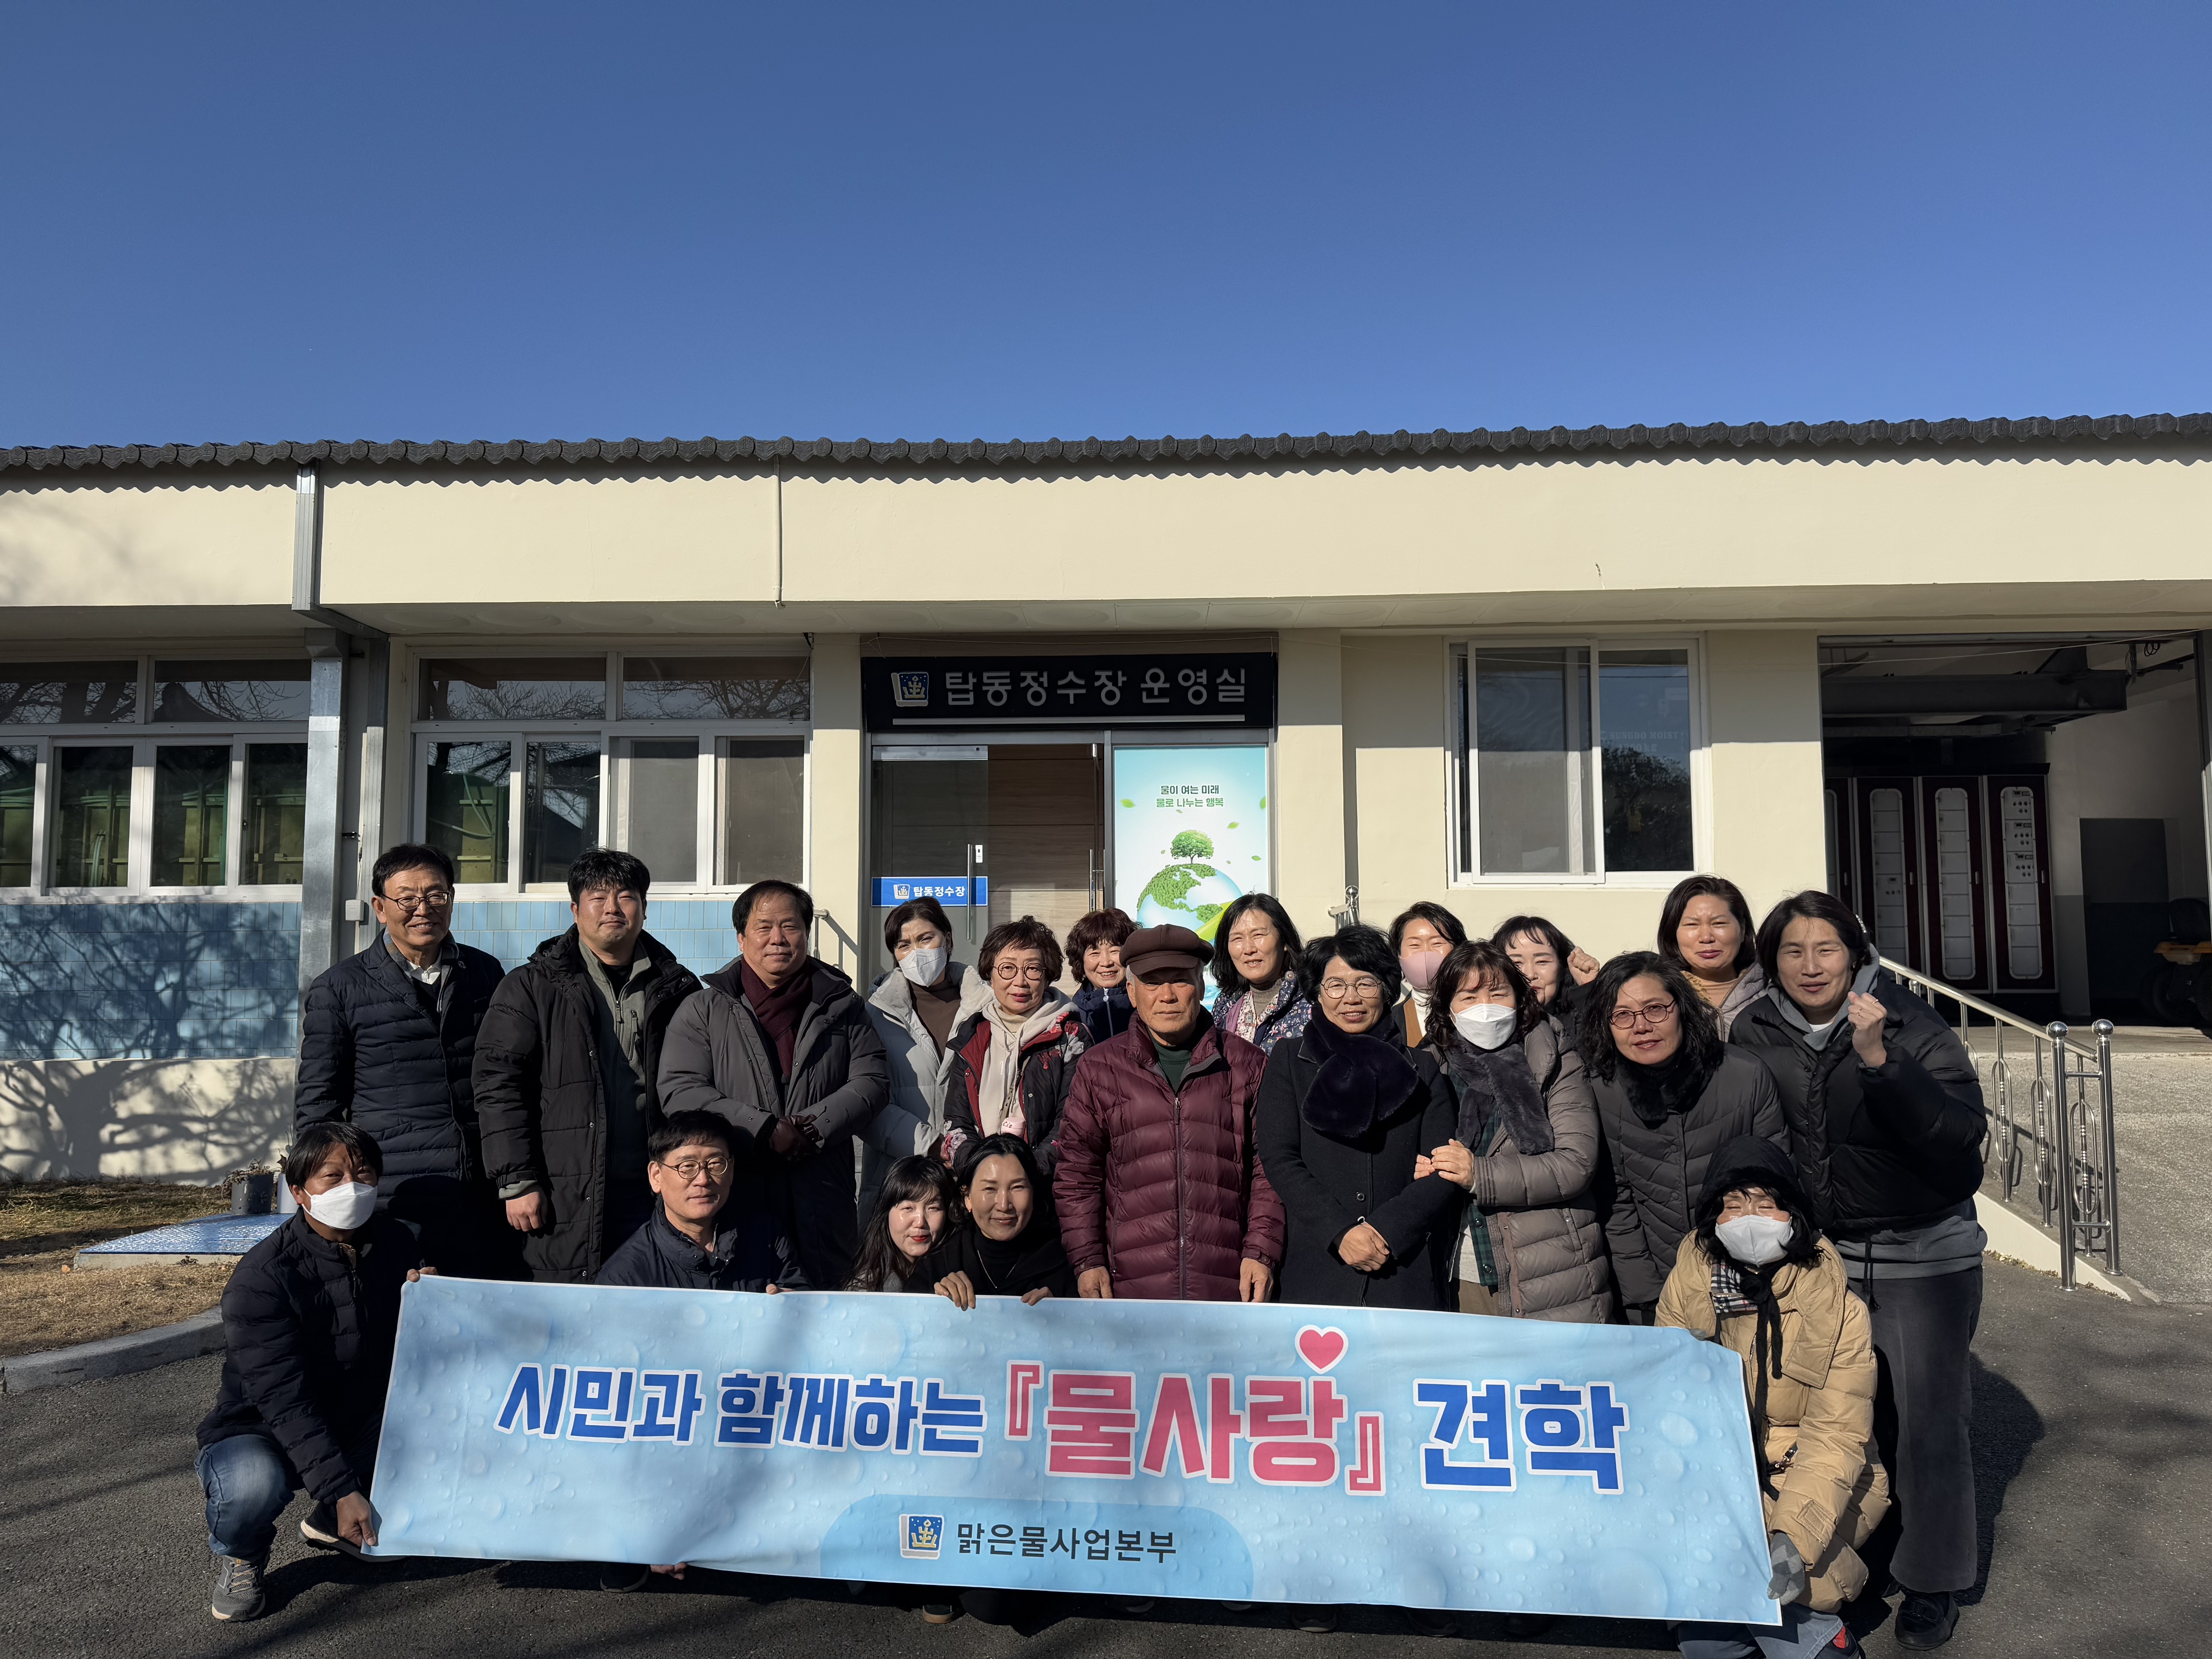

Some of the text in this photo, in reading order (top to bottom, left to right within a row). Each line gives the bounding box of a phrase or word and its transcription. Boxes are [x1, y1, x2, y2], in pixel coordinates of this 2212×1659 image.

[946, 668, 1245, 706] 탑동정수장 운영실
[1650, 731, 1679, 739] HOIST
[1161, 785, 1219, 795] 물이 여는 미래
[1156, 797, 1224, 808] 물로 나누는 행복
[913, 886, 965, 897] 탑동정수장
[496, 1365, 704, 1443] 시민과
[716, 1372, 985, 1455] 함께하는
[1416, 1381, 1626, 1491] 견학
[957, 1523, 1176, 1564] 맑은물사업본부
